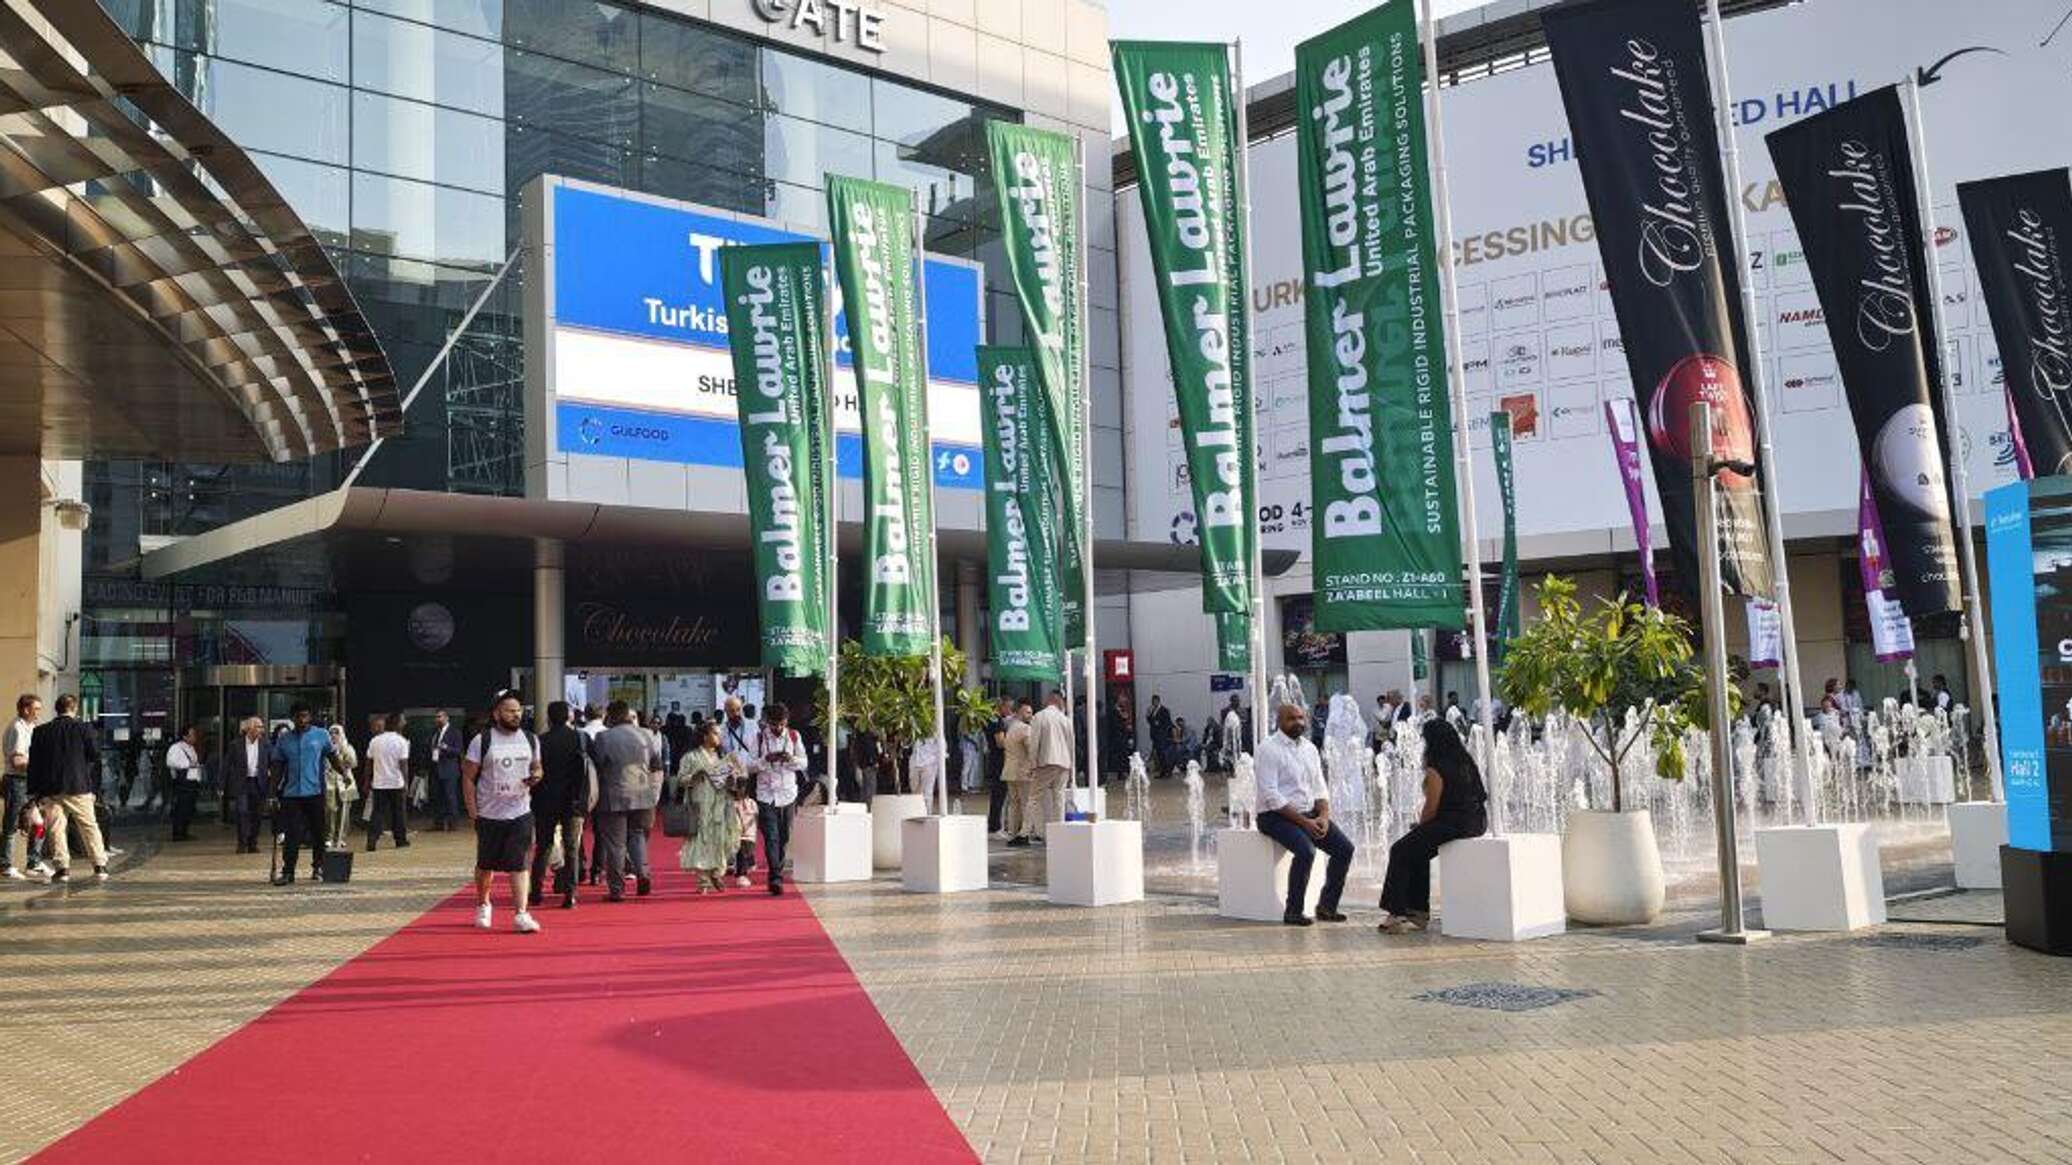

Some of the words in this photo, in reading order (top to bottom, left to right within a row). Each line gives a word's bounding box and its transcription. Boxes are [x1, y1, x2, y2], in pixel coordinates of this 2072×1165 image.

[1183, 72, 1211, 160] Emirates
[1357, 46, 1375, 141] Emirates
[1389, 32, 1408, 129] SOLUTIONS
[1142, 72, 1217, 286] Lawrie
[1202, 165, 1219, 213] Arab
[1312, 55, 1360, 288] Lawrie
[1359, 147, 1377, 197] Arab
[1396, 133, 1418, 239] PACKAGING
[1609, 40, 1702, 287] Chocolake
[847, 202, 893, 384] Lawrie
[1363, 204, 1383, 277] United
[1828, 140, 1914, 352] Chocolake
[738, 266, 788, 424] Lawrie
[776, 265, 793, 332] Emirates
[1405, 243, 1427, 350] INDUSTRIAL
[782, 336, 795, 371] Arab
[784, 375, 802, 425] United
[1412, 355, 1431, 404] RIGID
[610, 425, 669, 441] GULFOOD
[989, 364, 1018, 492] Lawrie
[1196, 295, 1243, 528] Balmer
[1322, 297, 1382, 539] Balmer
[761, 432, 803, 601] Balmer
[874, 392, 909, 584] Balmer
[1420, 410, 1441, 534] SUSTAINABLE
[998, 500, 1029, 632] Balmer
[1325, 572, 1371, 587] STAND
[1402, 571, 1445, 583] Z1-A60
[1326, 589, 1390, 602] ZA'ABEEL
[1393, 587, 1429, 600] HALL
